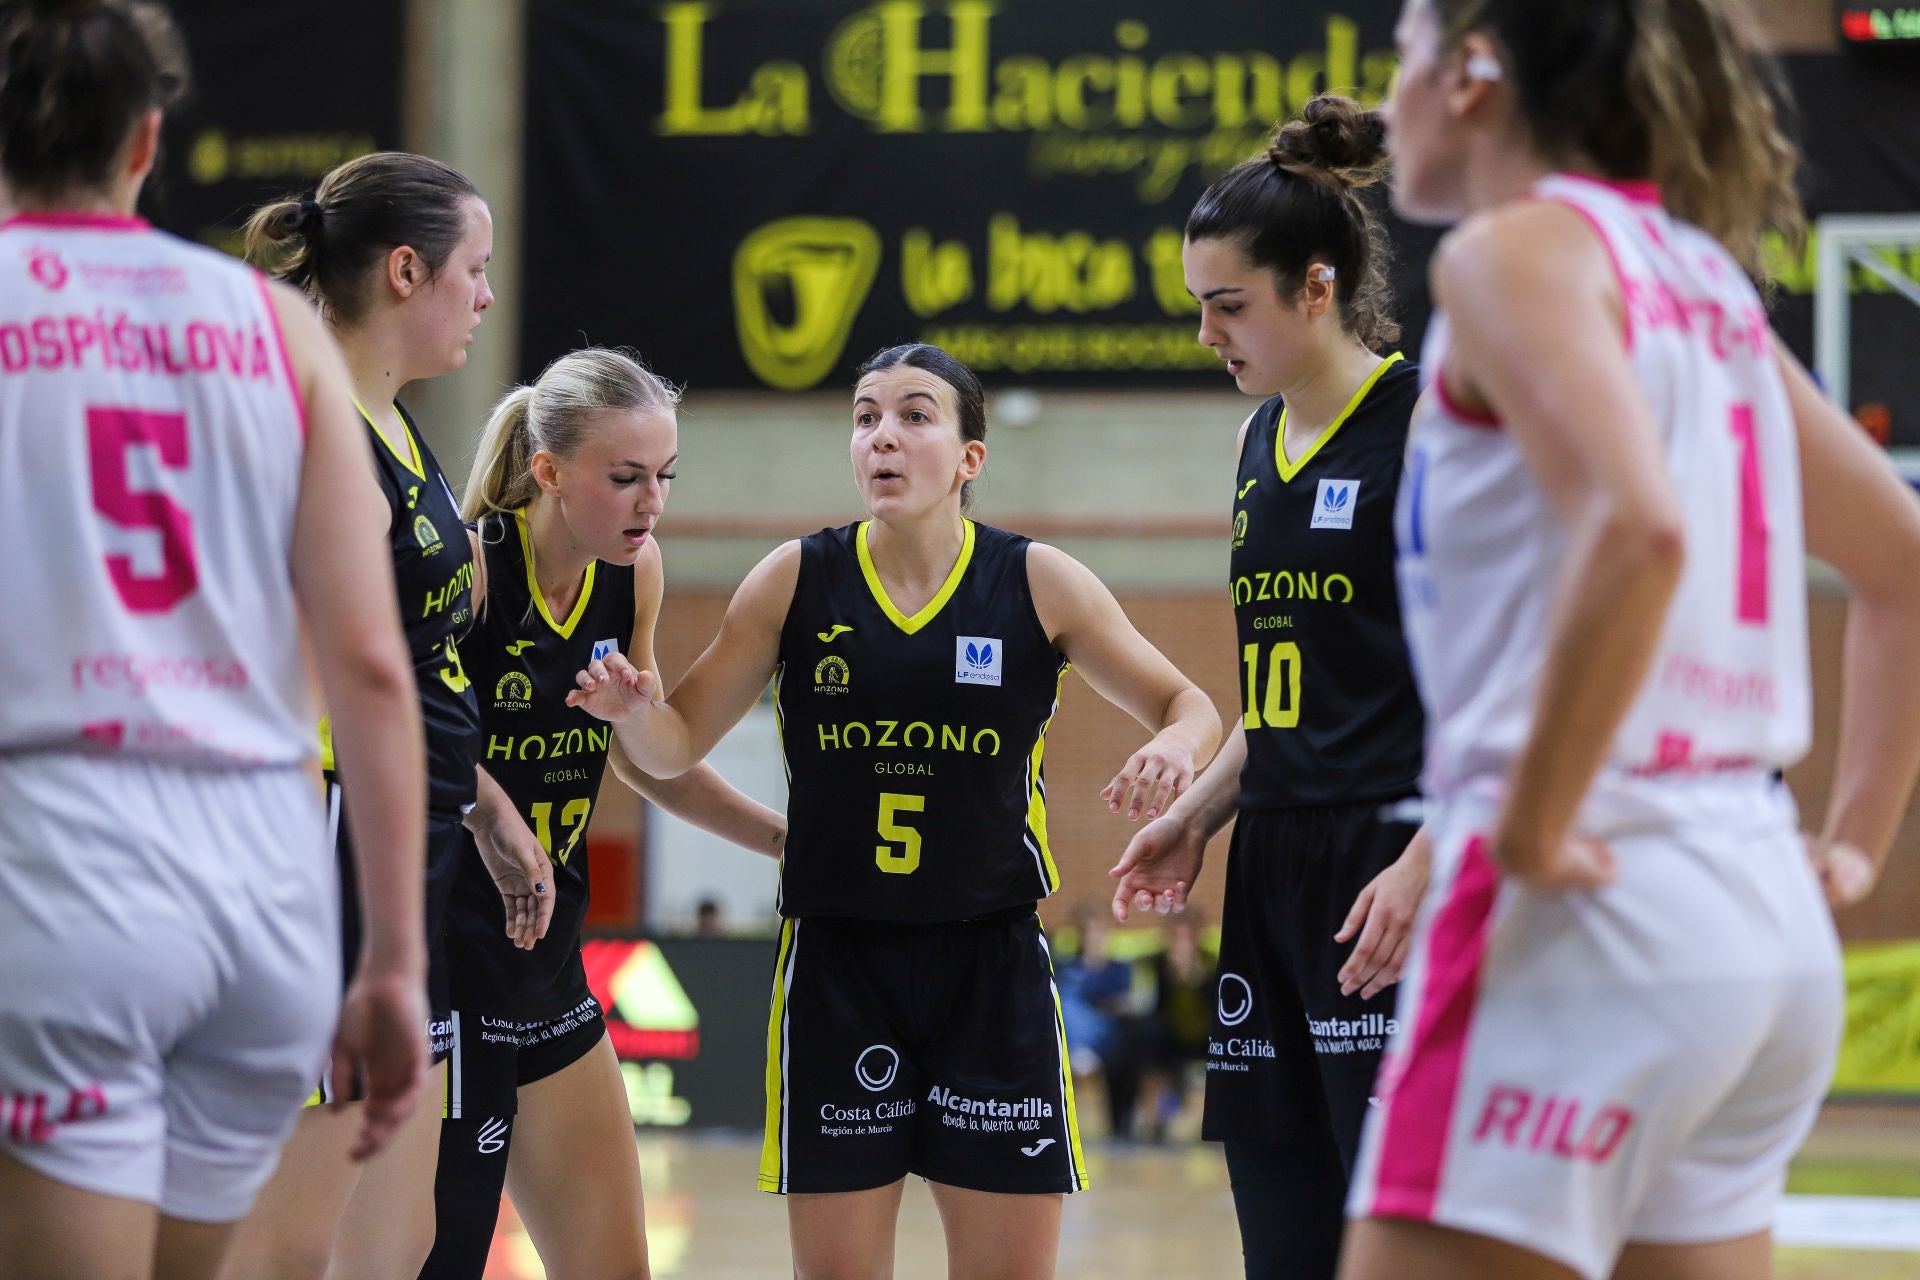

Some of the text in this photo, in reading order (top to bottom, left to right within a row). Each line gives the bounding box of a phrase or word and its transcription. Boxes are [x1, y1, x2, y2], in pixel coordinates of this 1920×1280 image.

[656, 2, 810, 136] La
[85, 404, 199, 616] 5
[1729, 403, 1768, 623] 1
[1253, 616, 1294, 630] GLOBAL
[814, 685, 849, 694] HOZONO
[1243, 641, 1302, 730] 10
[494, 701, 532, 710] HOZONO
[486, 725, 613, 761] HOZON
[817, 720, 1001, 756] HOZONO
[544, 768, 589, 783] GLOBAL
[874, 762, 935, 776] GLOBAL
[875, 792, 925, 875] 5
[1227, 1038, 1276, 1058] Cálida
[1357, 1037, 1383, 1052] nace
[1221, 1062, 1249, 1072] Murcia
[820, 1098, 916, 1121] Costa Cálida
[927, 1085, 1053, 1118] Alcantarilla
[821, 1124, 893, 1138] Región de Murcia
[942, 1112, 1041, 1133] donde la huerta nace
[1471, 1081, 1634, 1166] RILO
